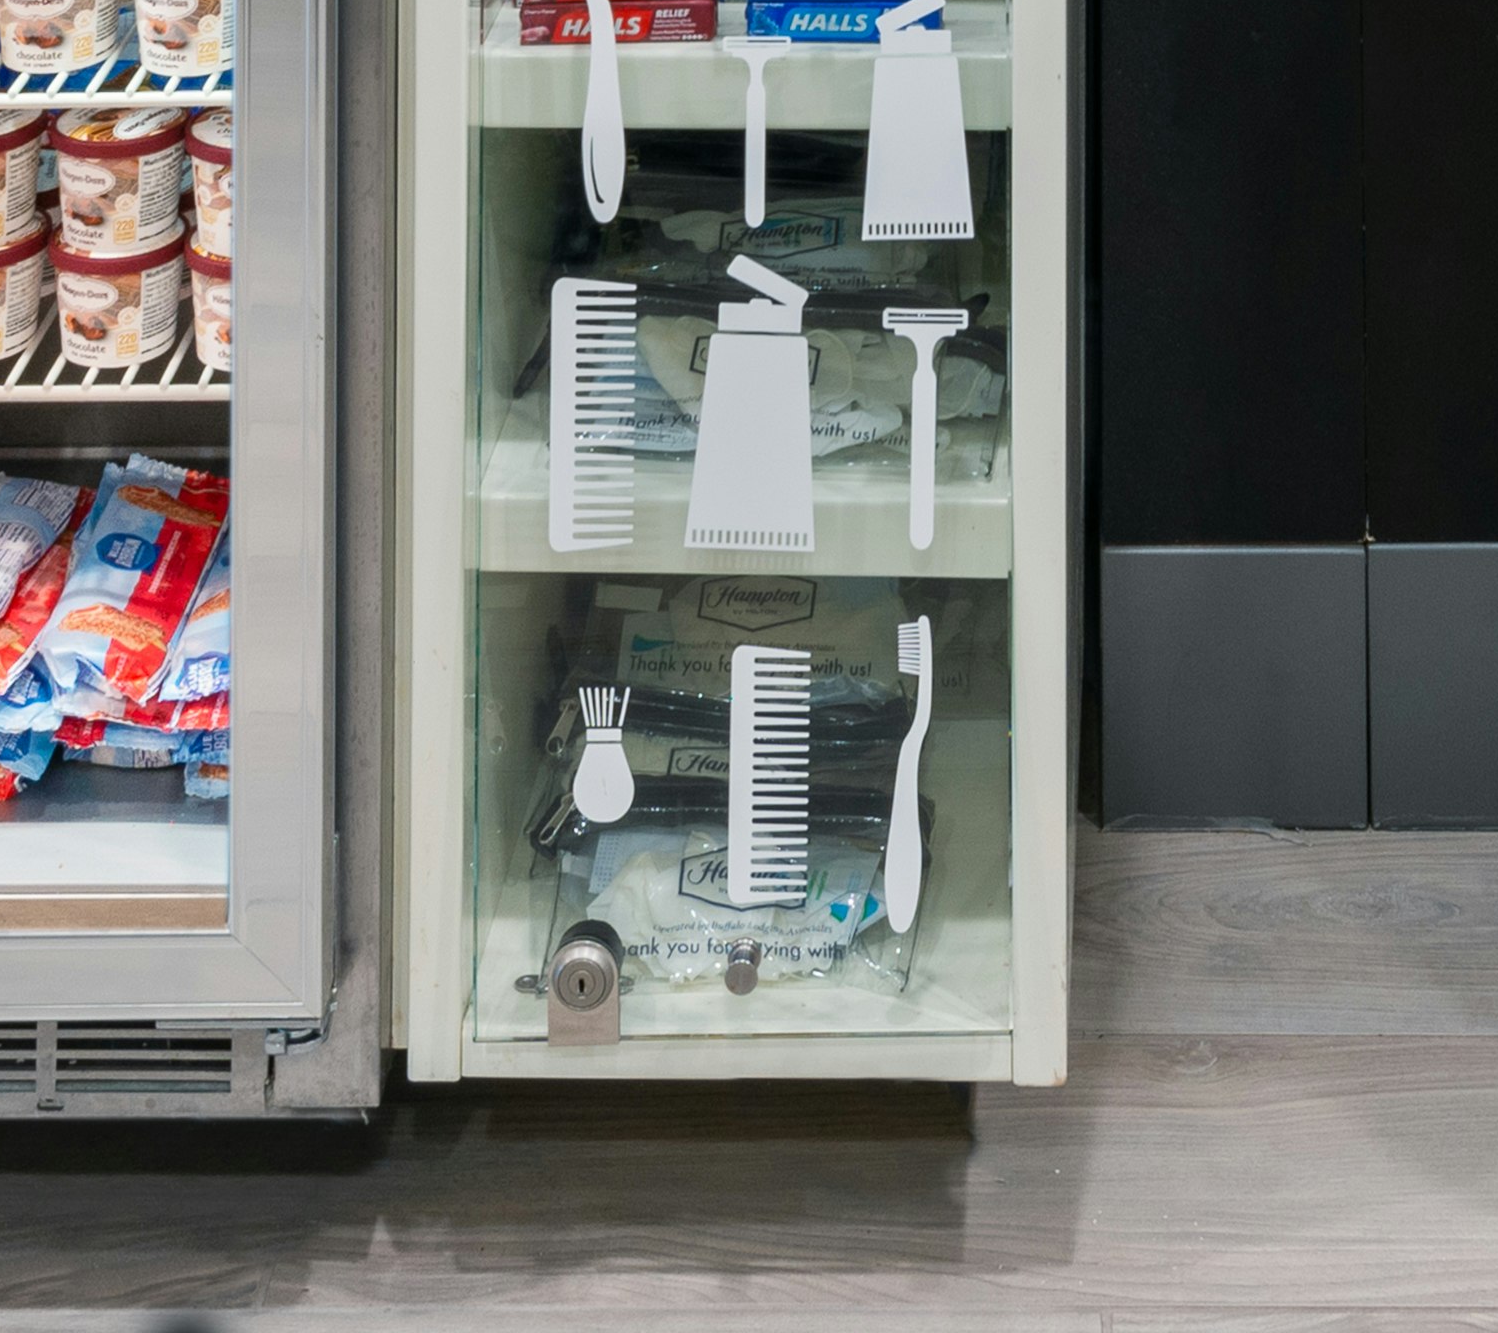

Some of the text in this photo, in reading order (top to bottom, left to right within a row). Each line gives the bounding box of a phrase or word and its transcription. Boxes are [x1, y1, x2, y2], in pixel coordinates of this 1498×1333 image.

[655, 9, 690, 18] RELIEF
[790, 14, 868, 32] HALLS
[704, 586, 809, 610] Hampton
[630, 656, 712, 672] Thank you
[850, 661, 871, 677] us!
[667, 942, 701, 961] you
